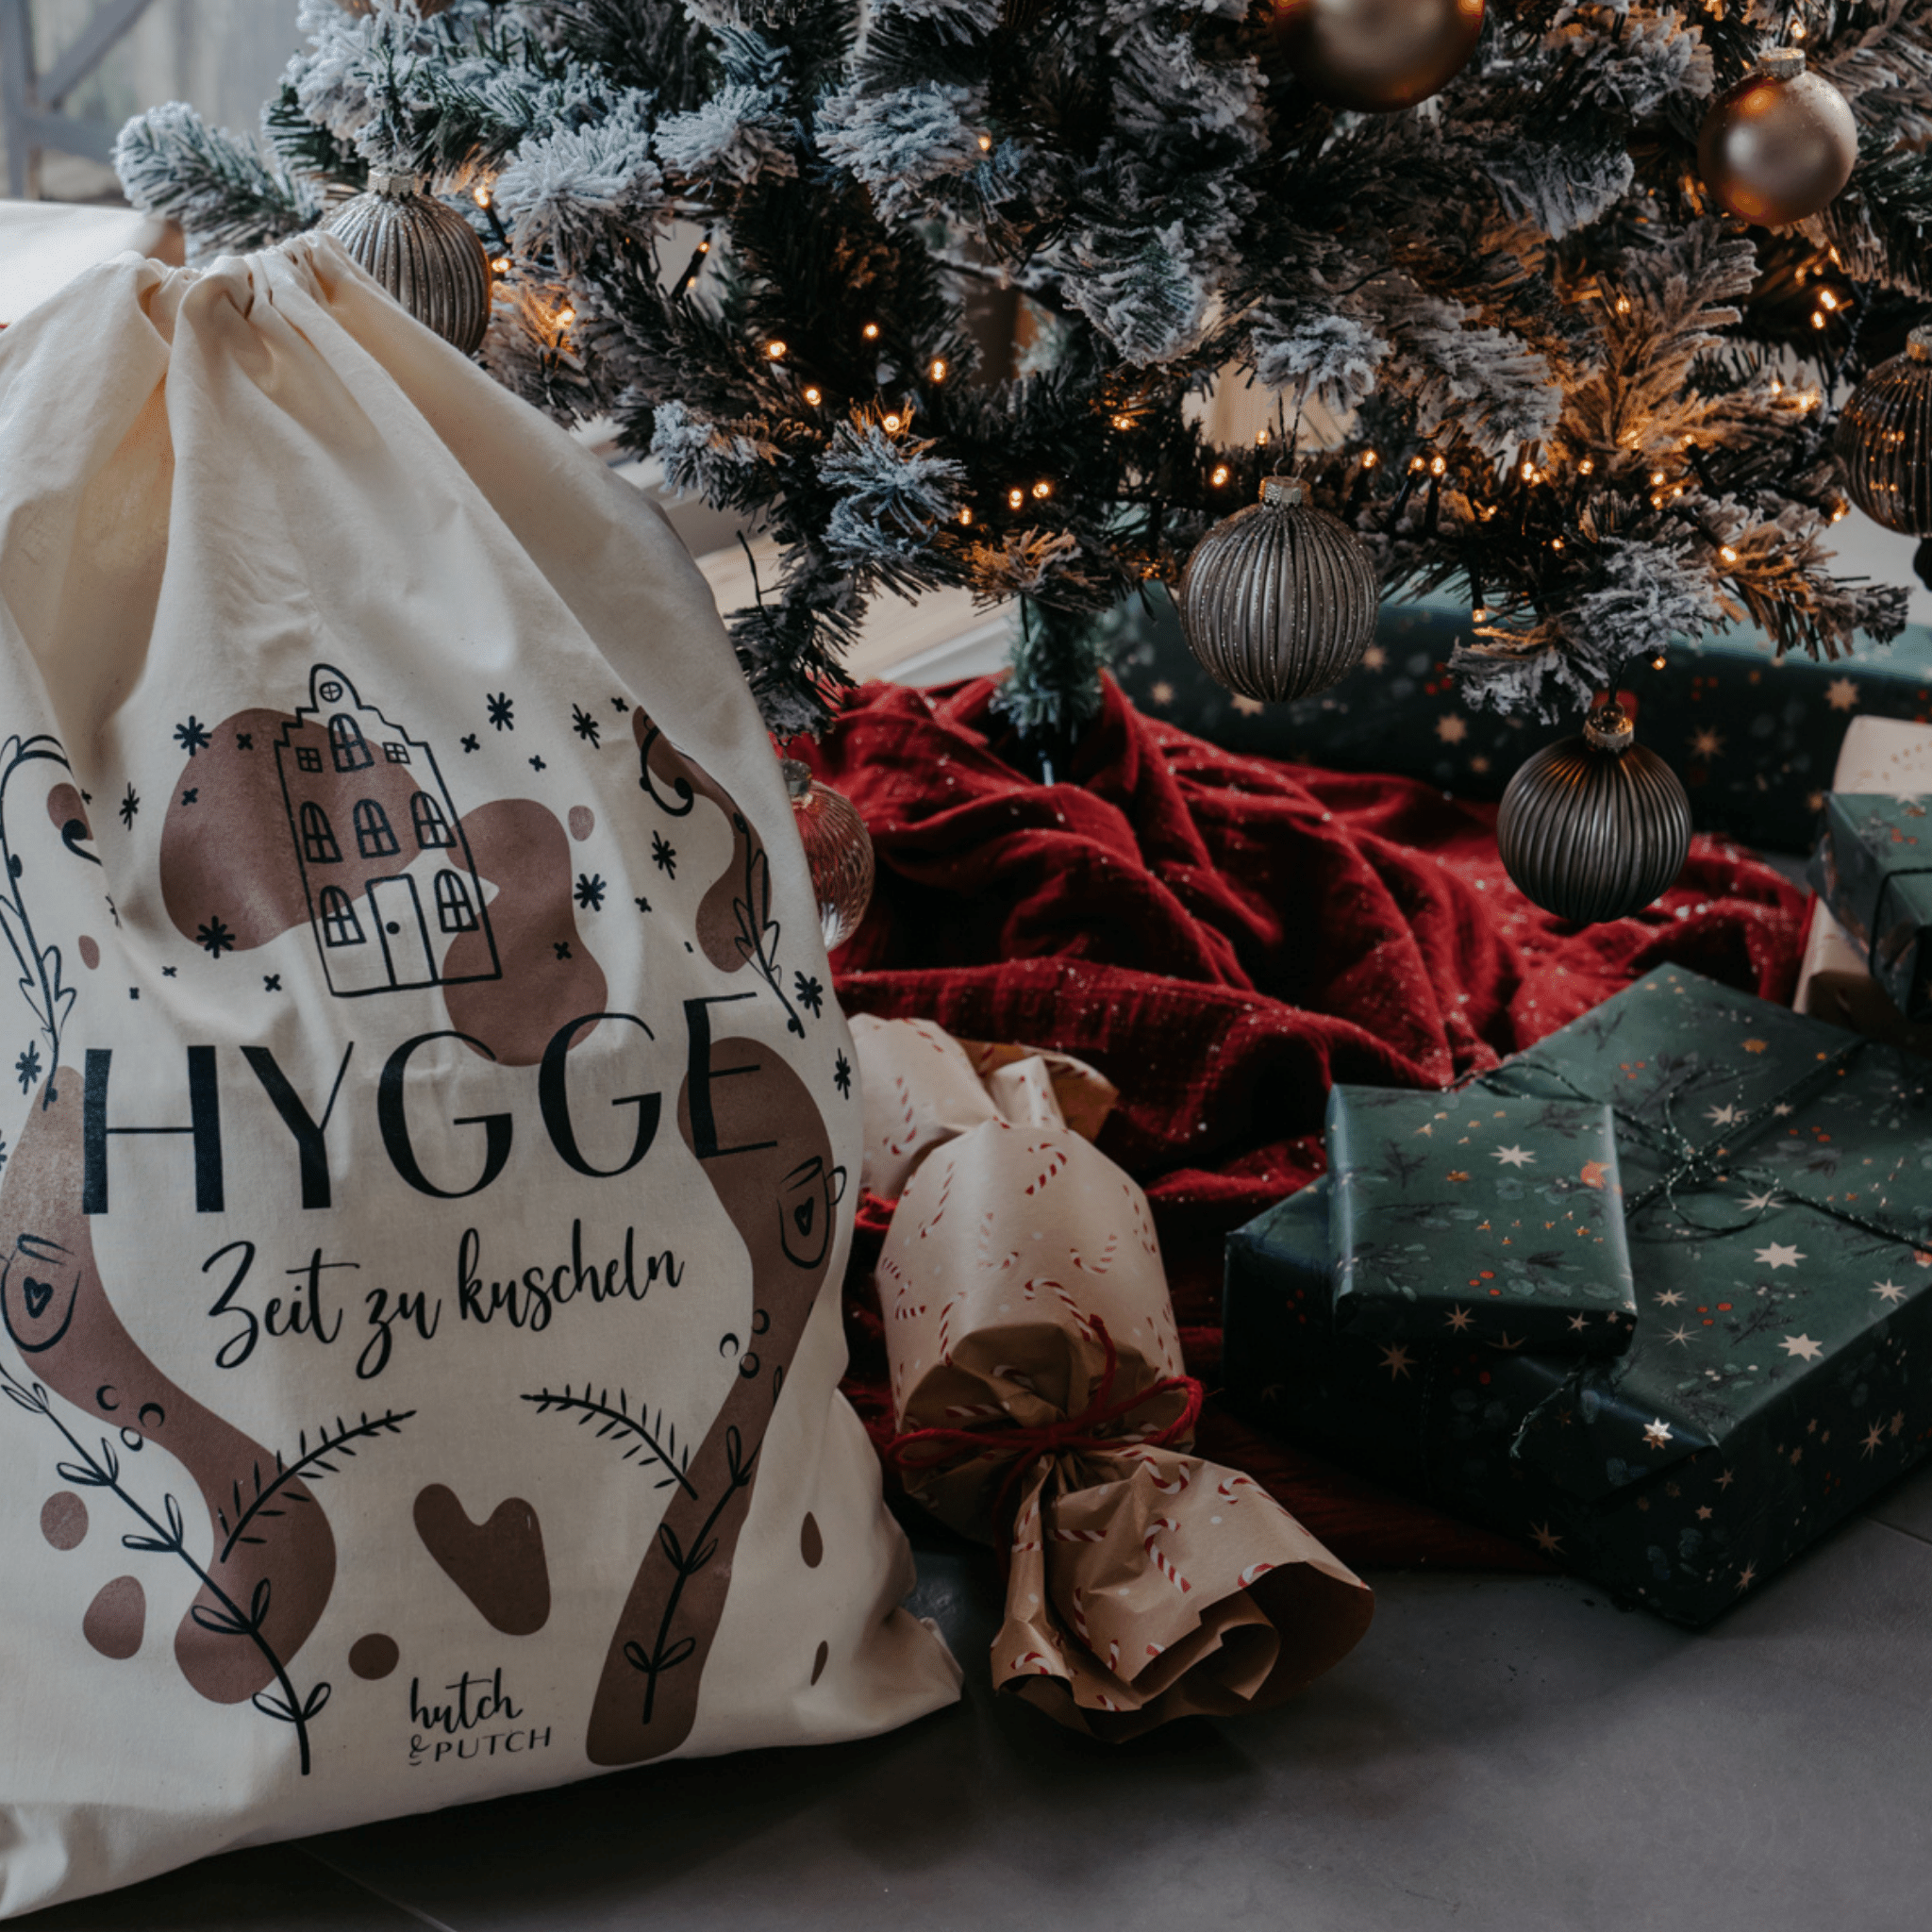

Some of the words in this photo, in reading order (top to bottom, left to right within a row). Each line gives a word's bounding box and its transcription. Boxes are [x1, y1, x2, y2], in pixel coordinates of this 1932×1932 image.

[82, 991, 779, 1216] HYGGE
[201, 1241, 361, 1370] Zeit
[355, 1287, 442, 1380] zu
[458, 1218, 685, 1332] kuscheln
[409, 1666, 525, 1735] hutch
